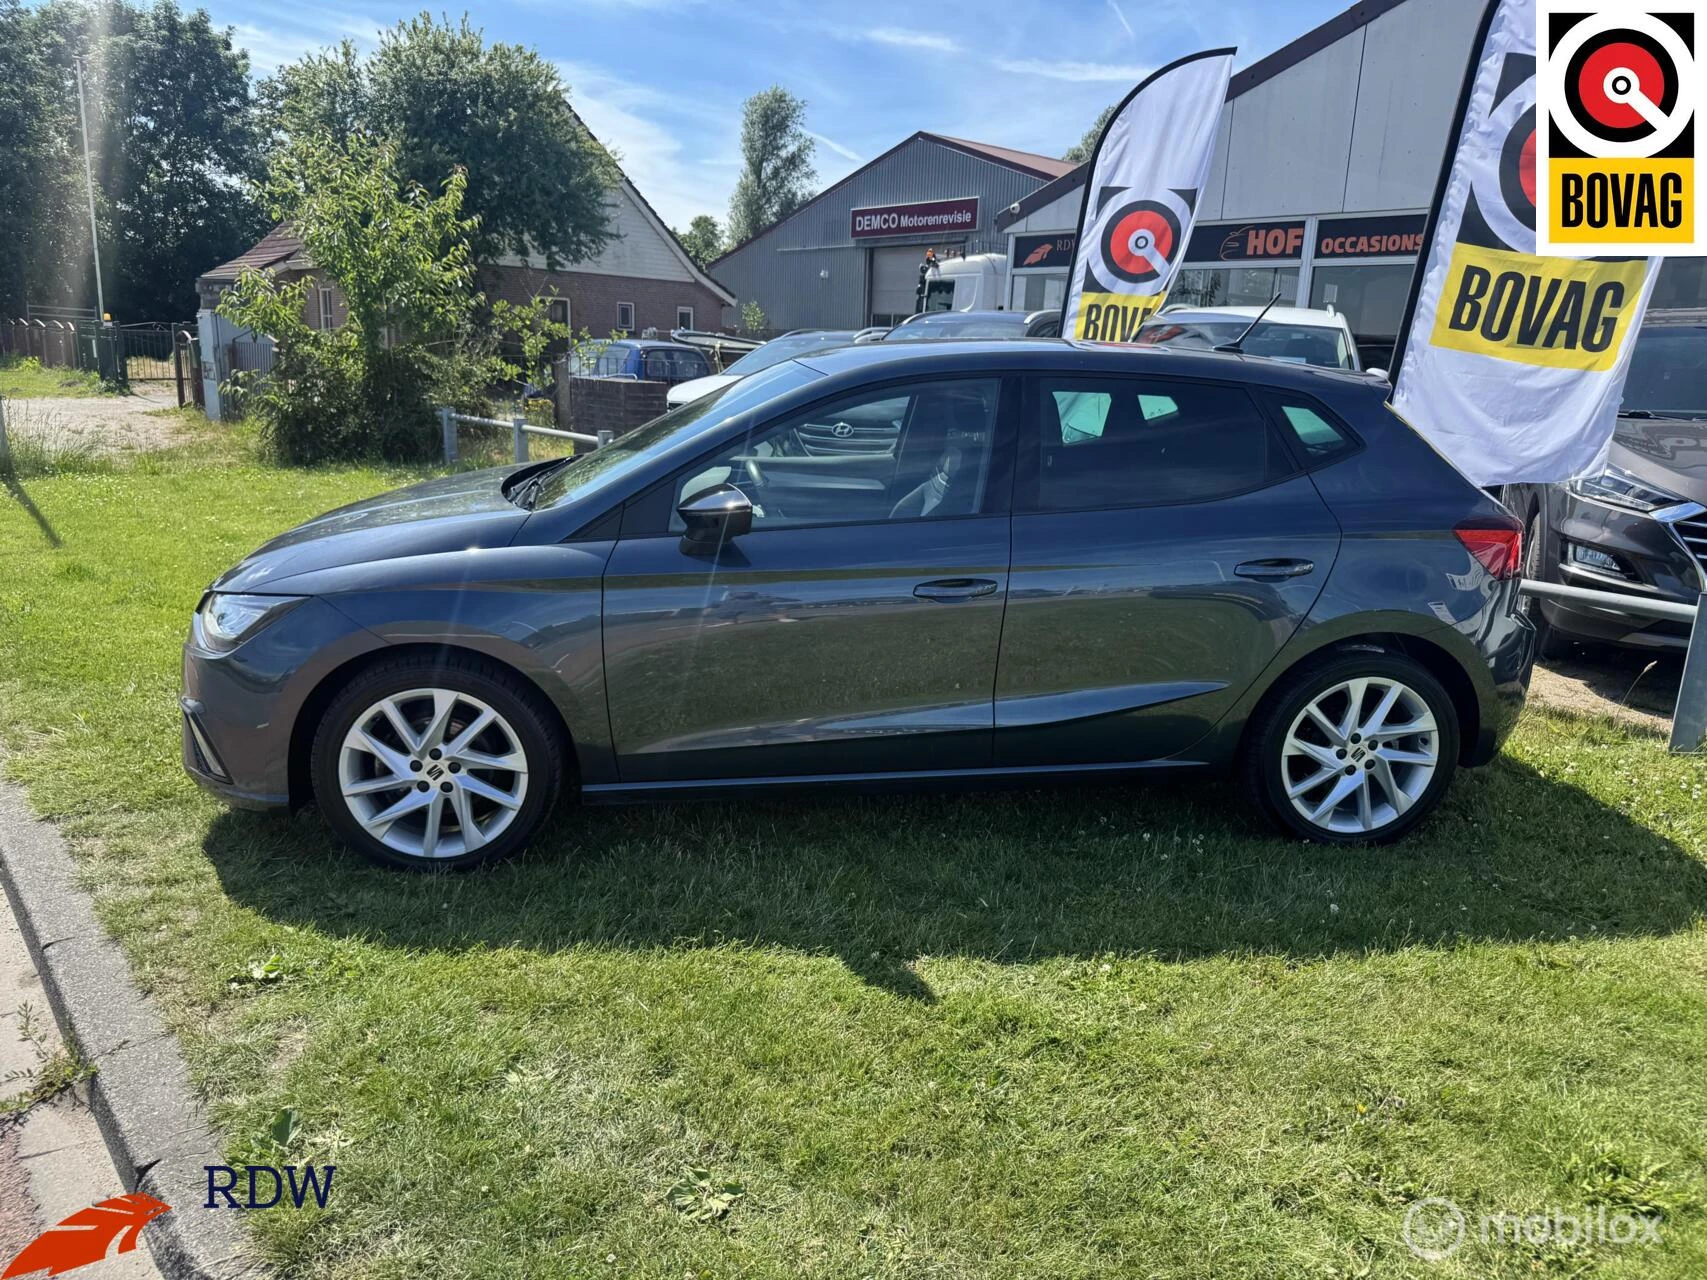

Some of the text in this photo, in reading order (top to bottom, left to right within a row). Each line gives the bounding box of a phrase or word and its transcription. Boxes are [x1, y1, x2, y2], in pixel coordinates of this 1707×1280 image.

[856, 210, 971, 231] DEMCO Motorenrevisie
[1246, 228, 1303, 256] HOF
[1321, 233, 1423, 254] OCCASIONS
[1449, 264, 1625, 353] BOVAG
